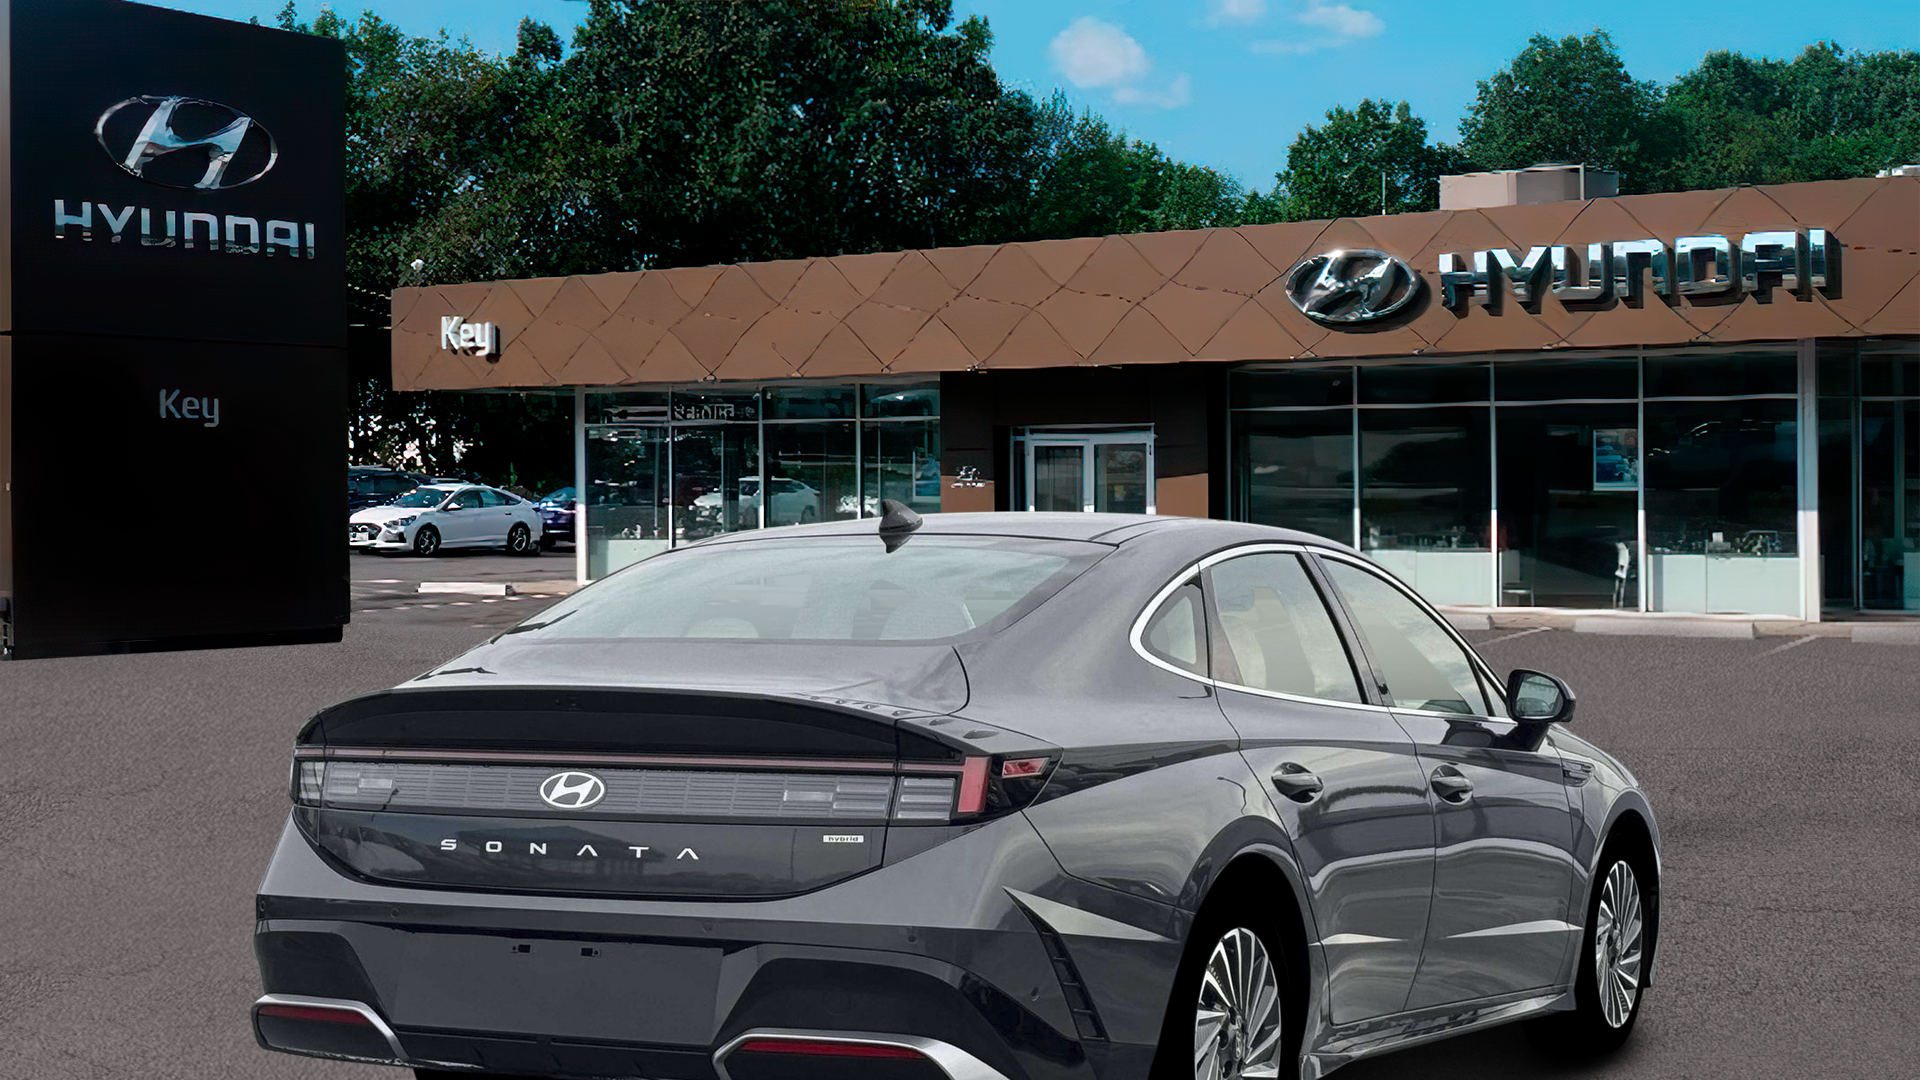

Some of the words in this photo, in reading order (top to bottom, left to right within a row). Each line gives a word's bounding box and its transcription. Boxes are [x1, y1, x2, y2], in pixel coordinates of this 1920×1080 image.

[54, 199, 315, 260] HYUNDAI
[1438, 229, 1834, 307] HYUNDAI
[441, 315, 492, 357] Key
[160, 388, 219, 427] Key
